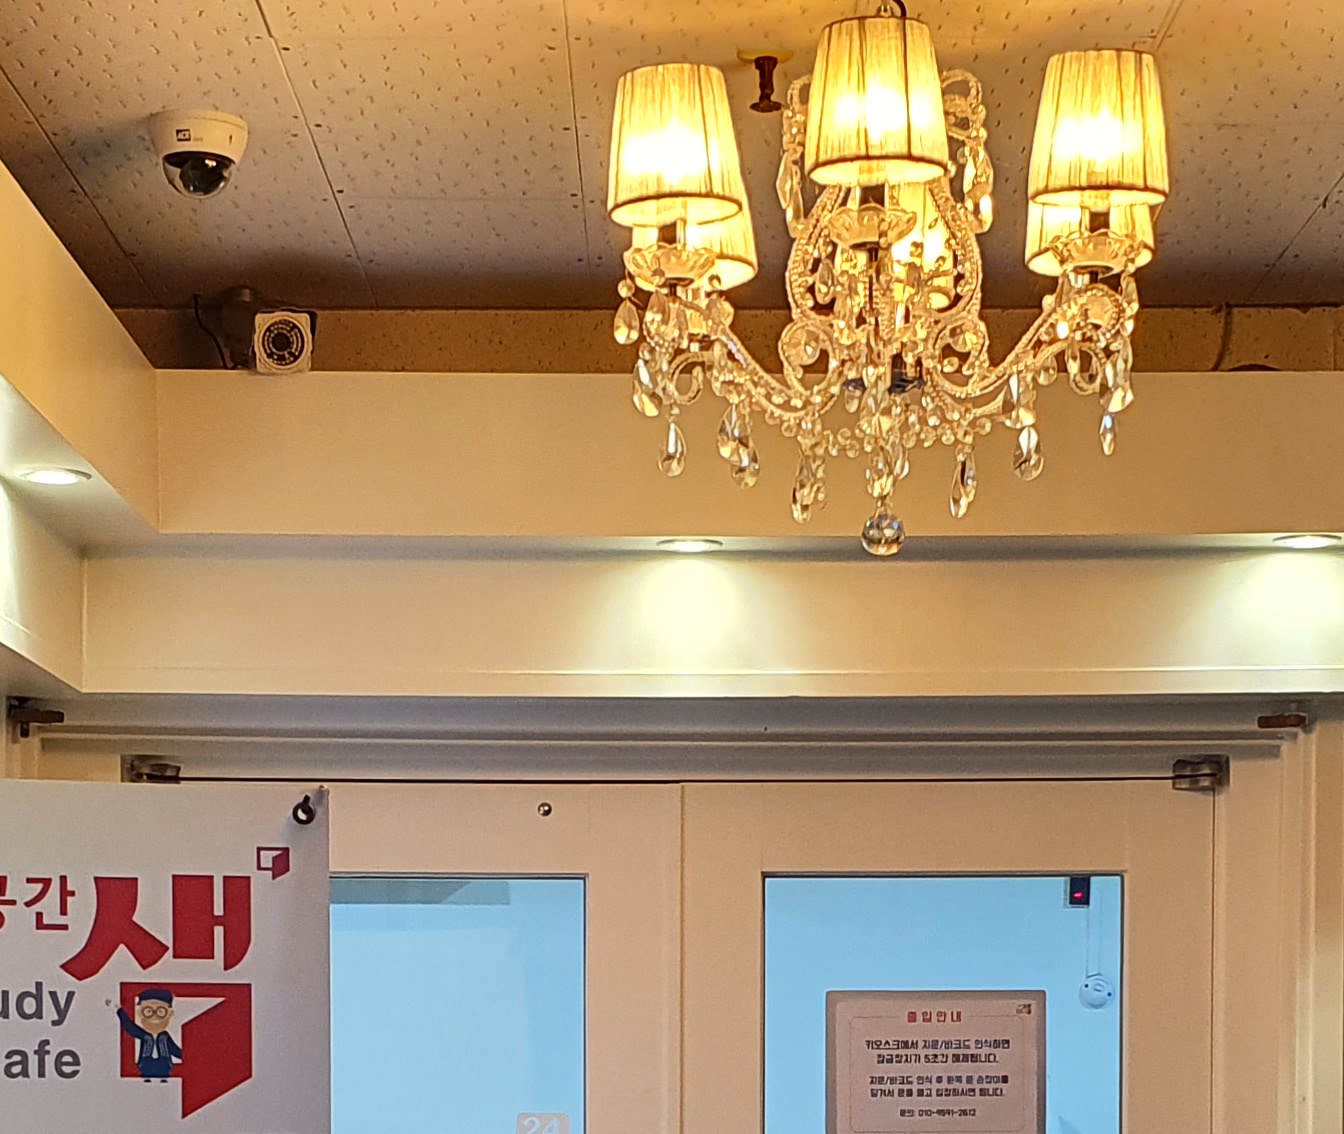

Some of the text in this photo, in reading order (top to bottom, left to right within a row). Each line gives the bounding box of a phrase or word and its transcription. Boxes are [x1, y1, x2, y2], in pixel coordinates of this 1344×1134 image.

[865, 1039, 1010, 1050] 키오스크에서 지문/바코드 인식하면
[877, 1054, 921, 1064] 잠금장치가
[924, 1053, 949, 1064] 5초간
[869, 1075, 933, 1085] 지문/바코드 인식
